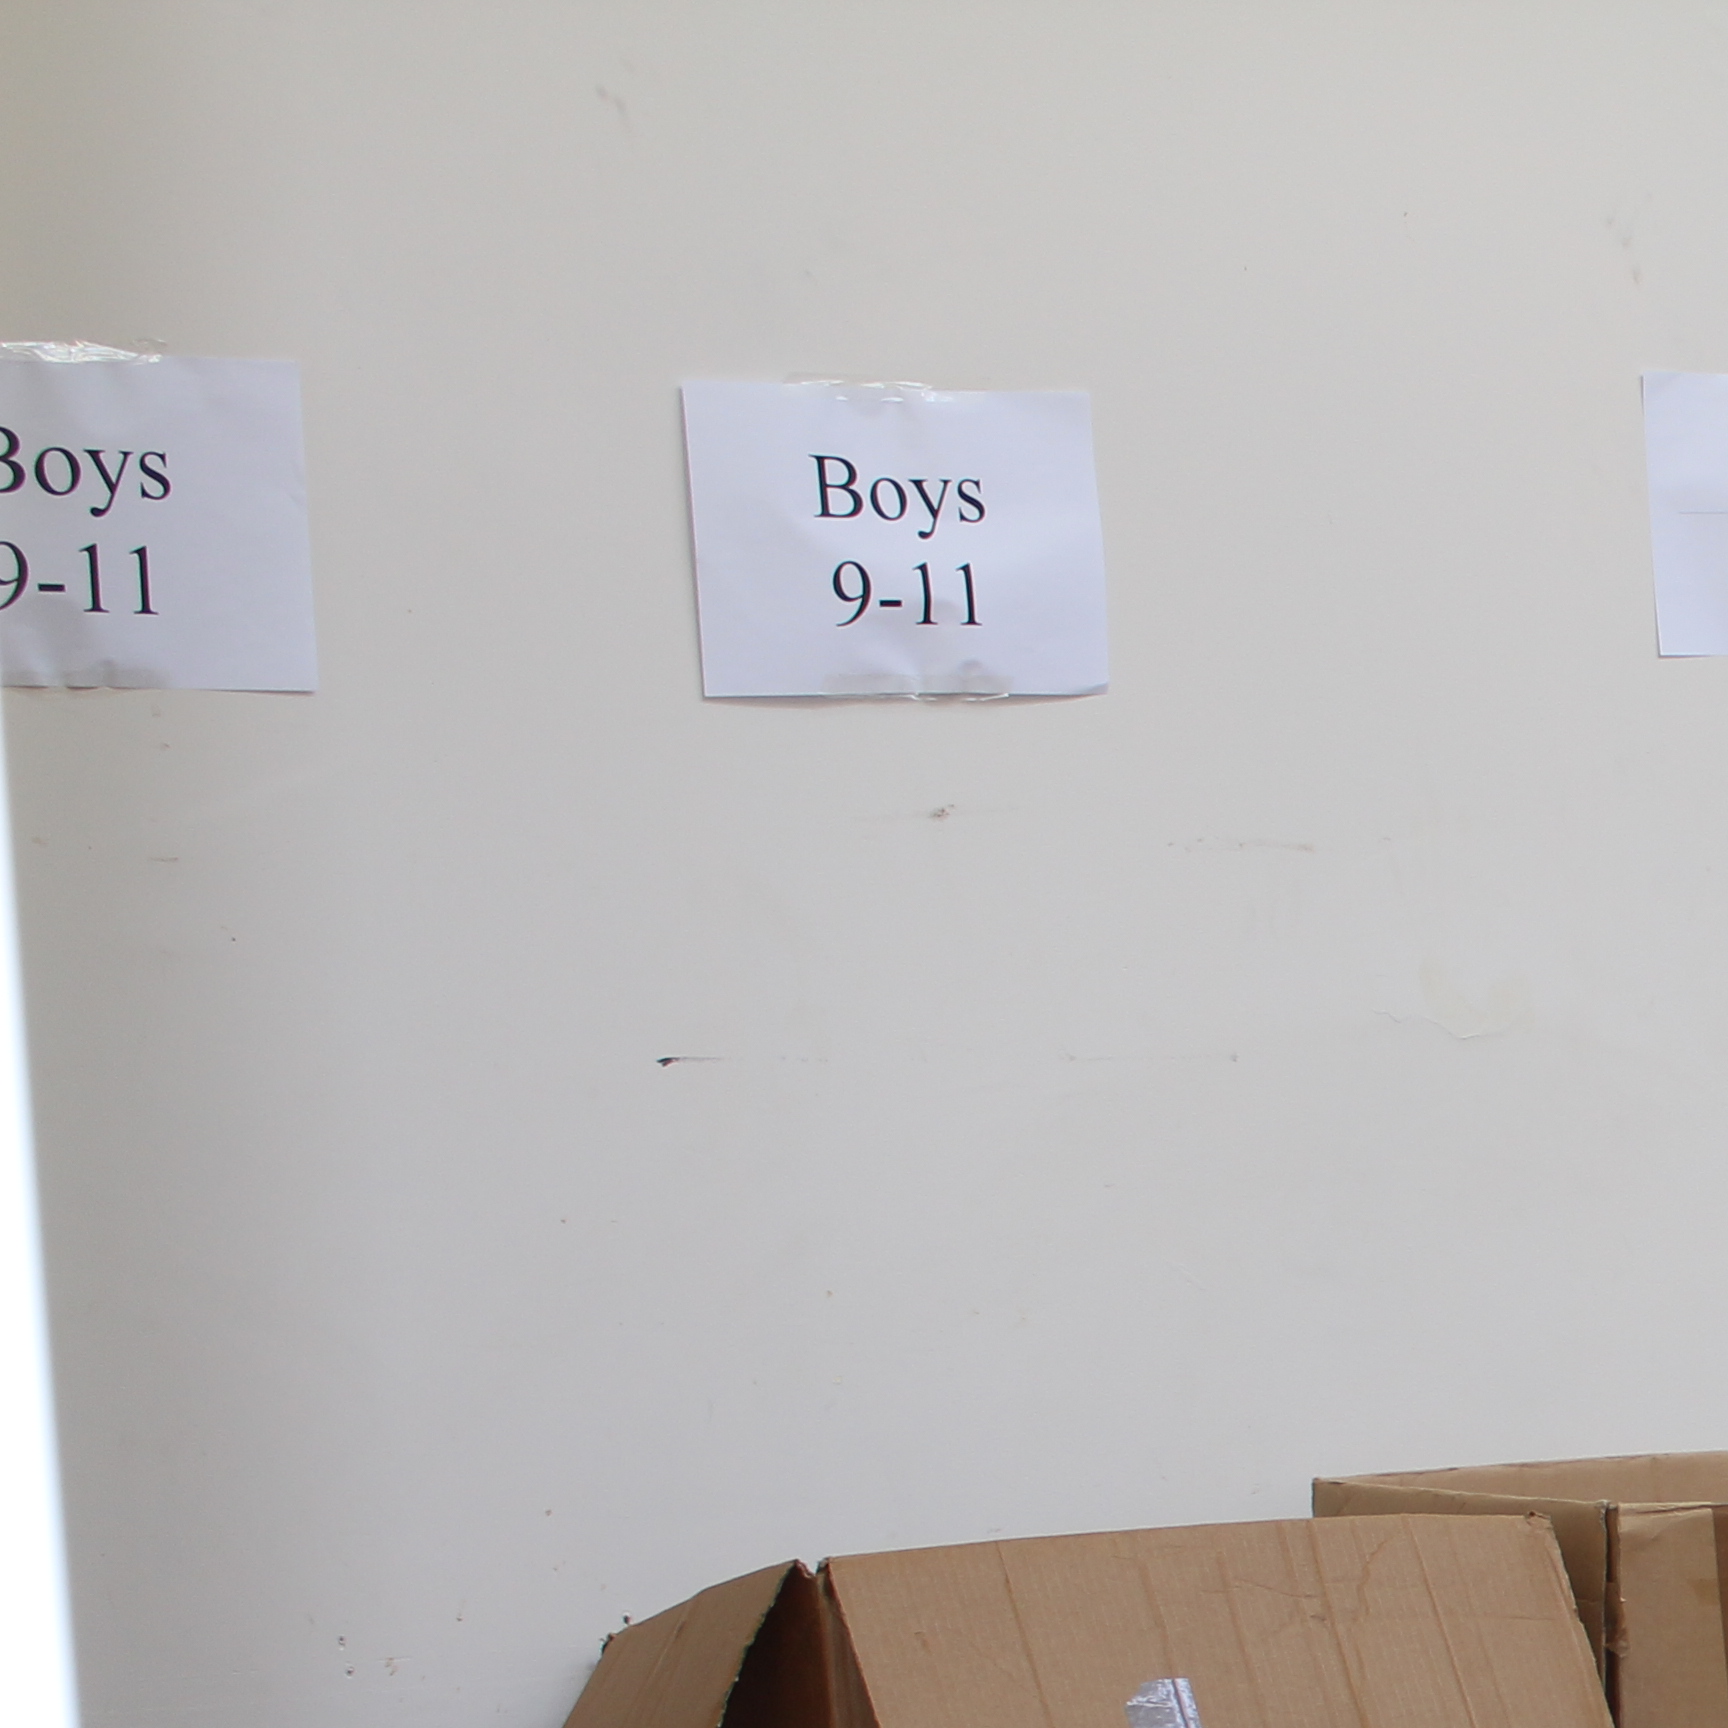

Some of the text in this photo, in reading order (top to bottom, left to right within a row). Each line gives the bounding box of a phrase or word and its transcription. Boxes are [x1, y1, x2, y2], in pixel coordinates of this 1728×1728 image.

[809, 454, 986, 540] Boys
[0, 541, 158, 616] 9-11
[831, 560, 982, 628] 9-11
